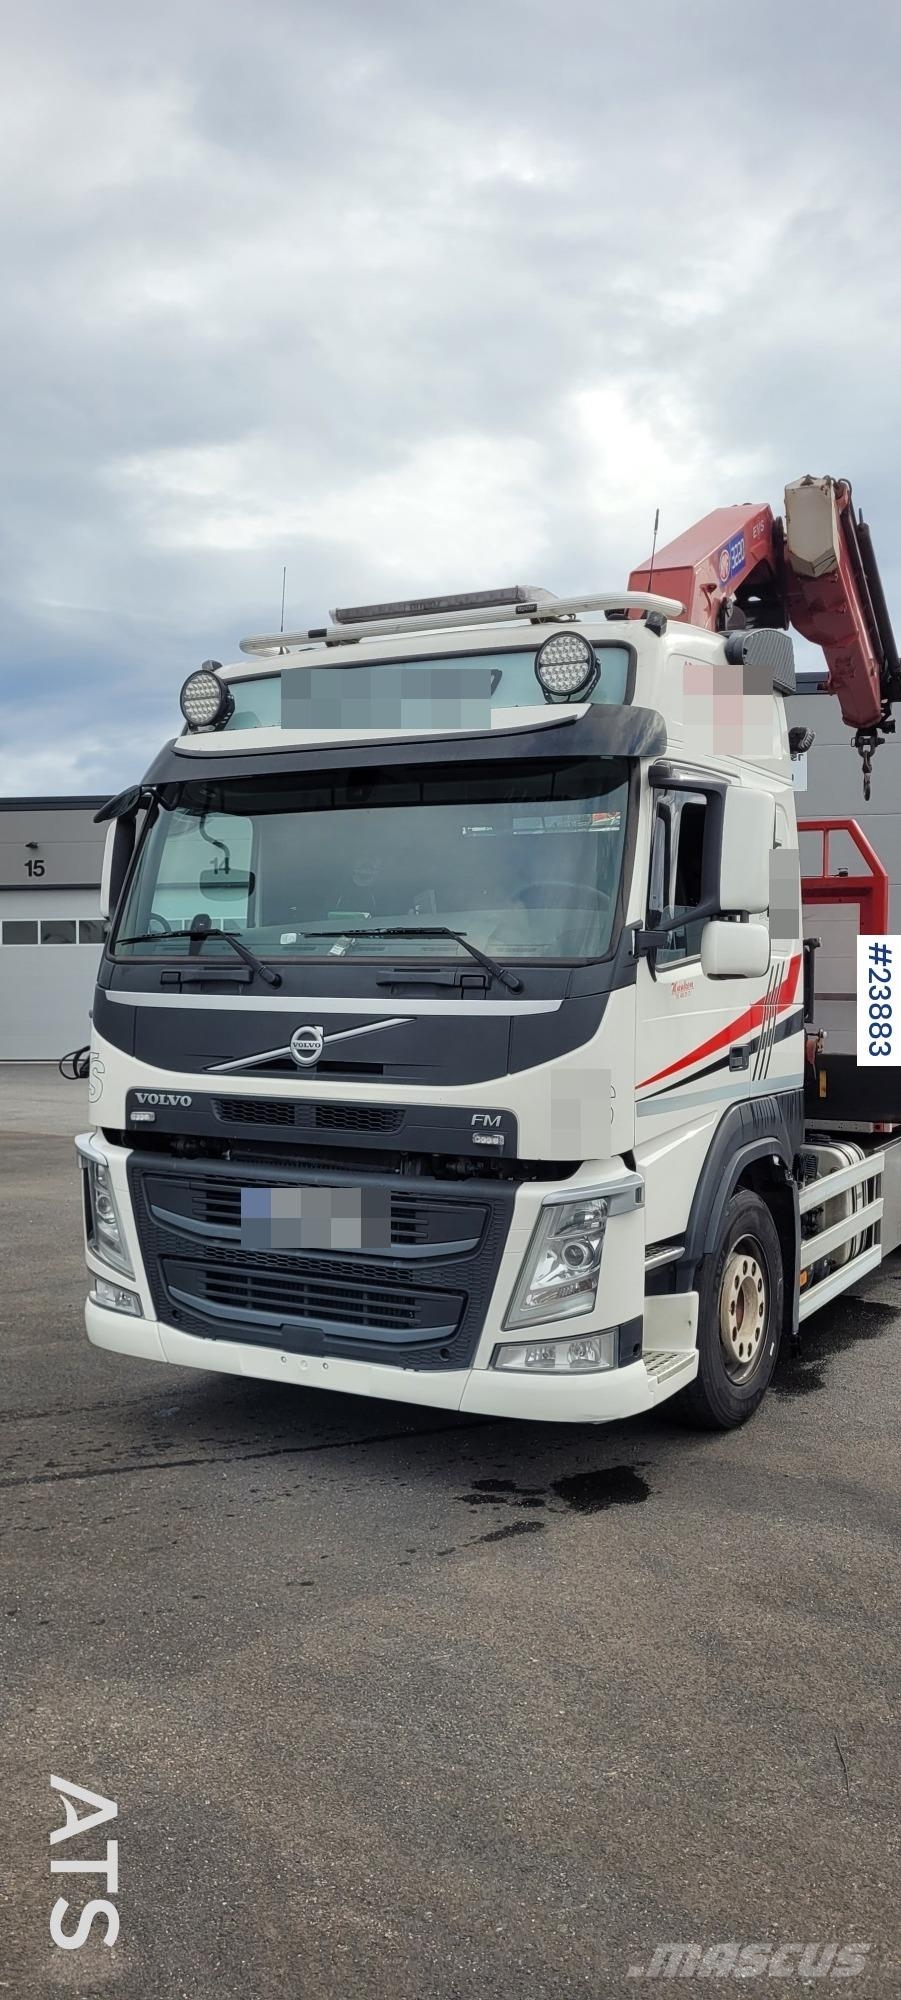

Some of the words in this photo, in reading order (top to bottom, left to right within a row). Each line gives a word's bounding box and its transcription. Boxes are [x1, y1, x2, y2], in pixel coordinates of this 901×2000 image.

[24, 860, 45, 877] 15
[135, 1092, 192, 1107] VOLVO
[471, 1114, 502, 1127] FM
